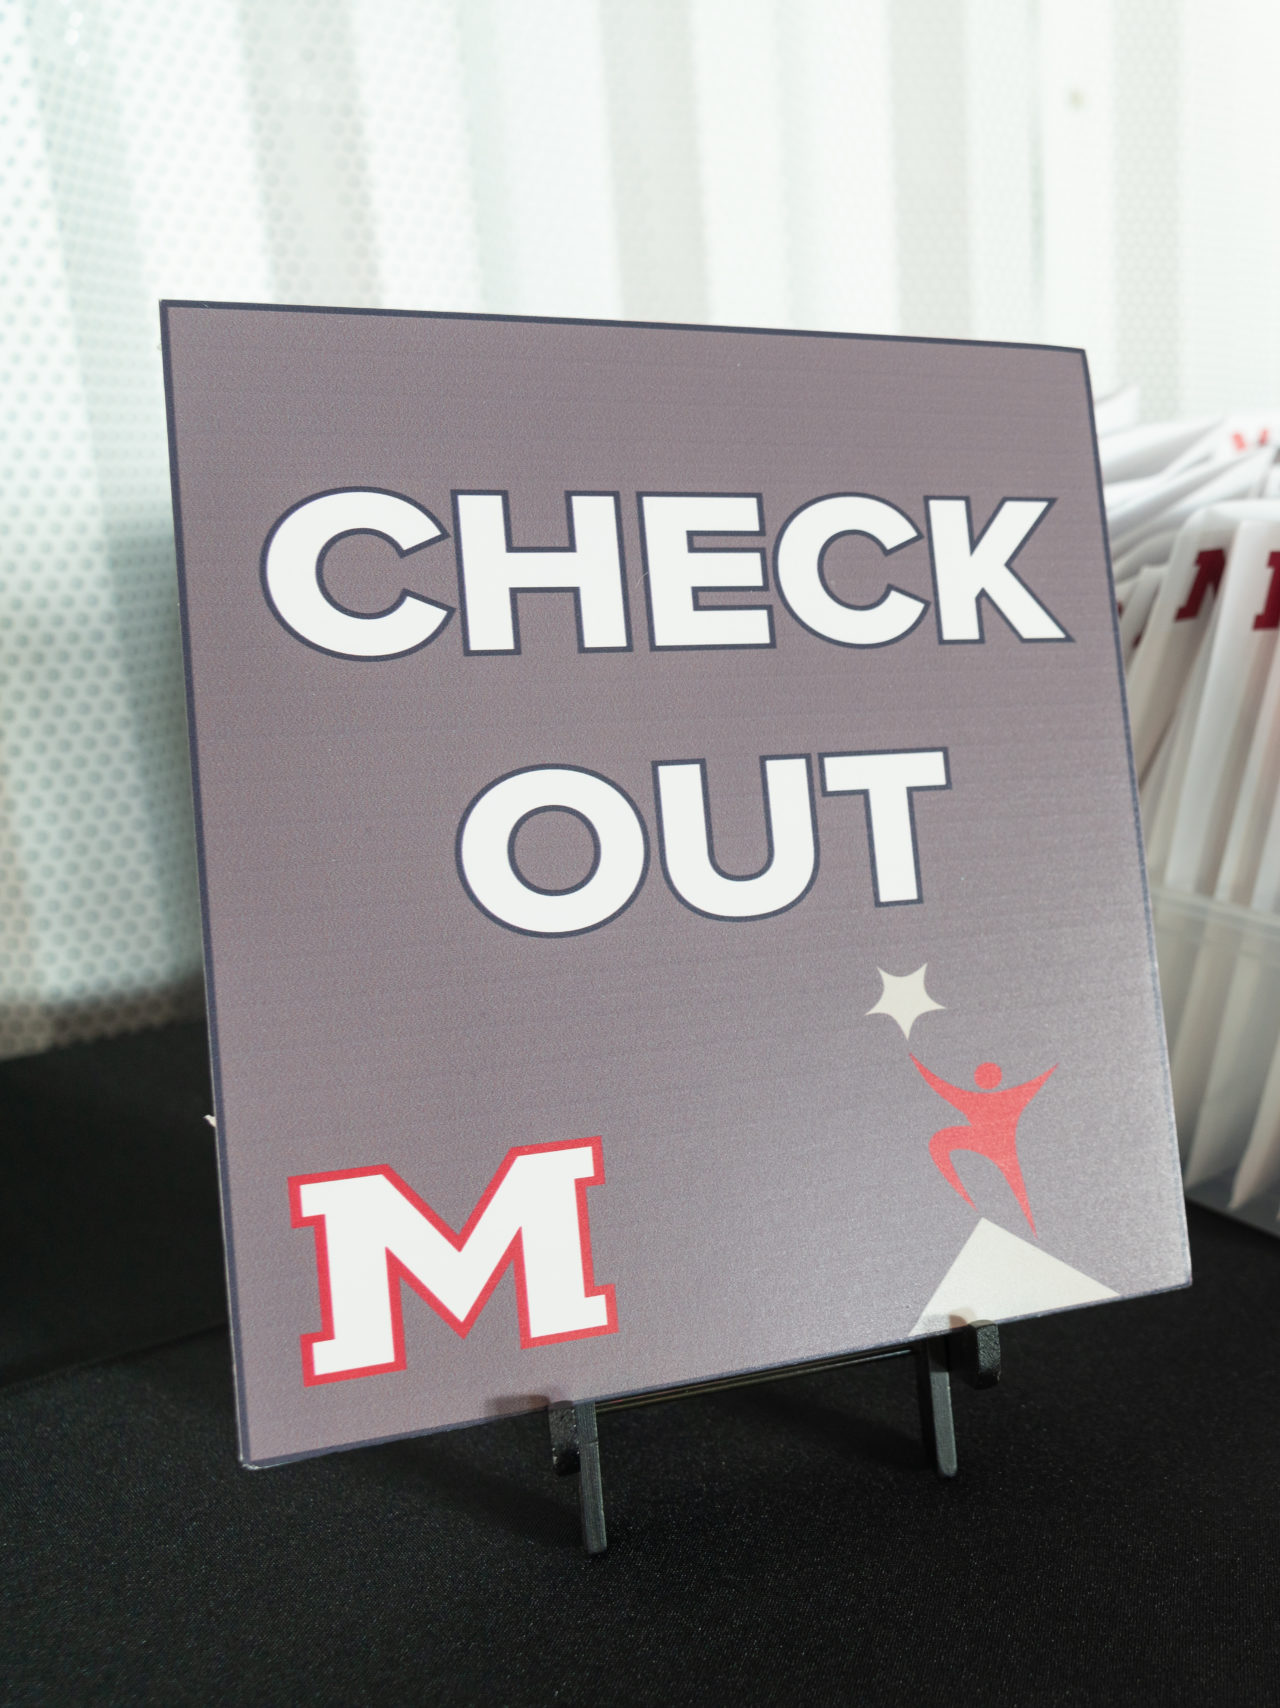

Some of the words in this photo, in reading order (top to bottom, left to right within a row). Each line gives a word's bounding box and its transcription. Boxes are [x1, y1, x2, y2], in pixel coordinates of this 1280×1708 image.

[260, 486, 1075, 662] CHECK
[455, 747, 951, 939] OUT
[288, 1135, 619, 1387] M
